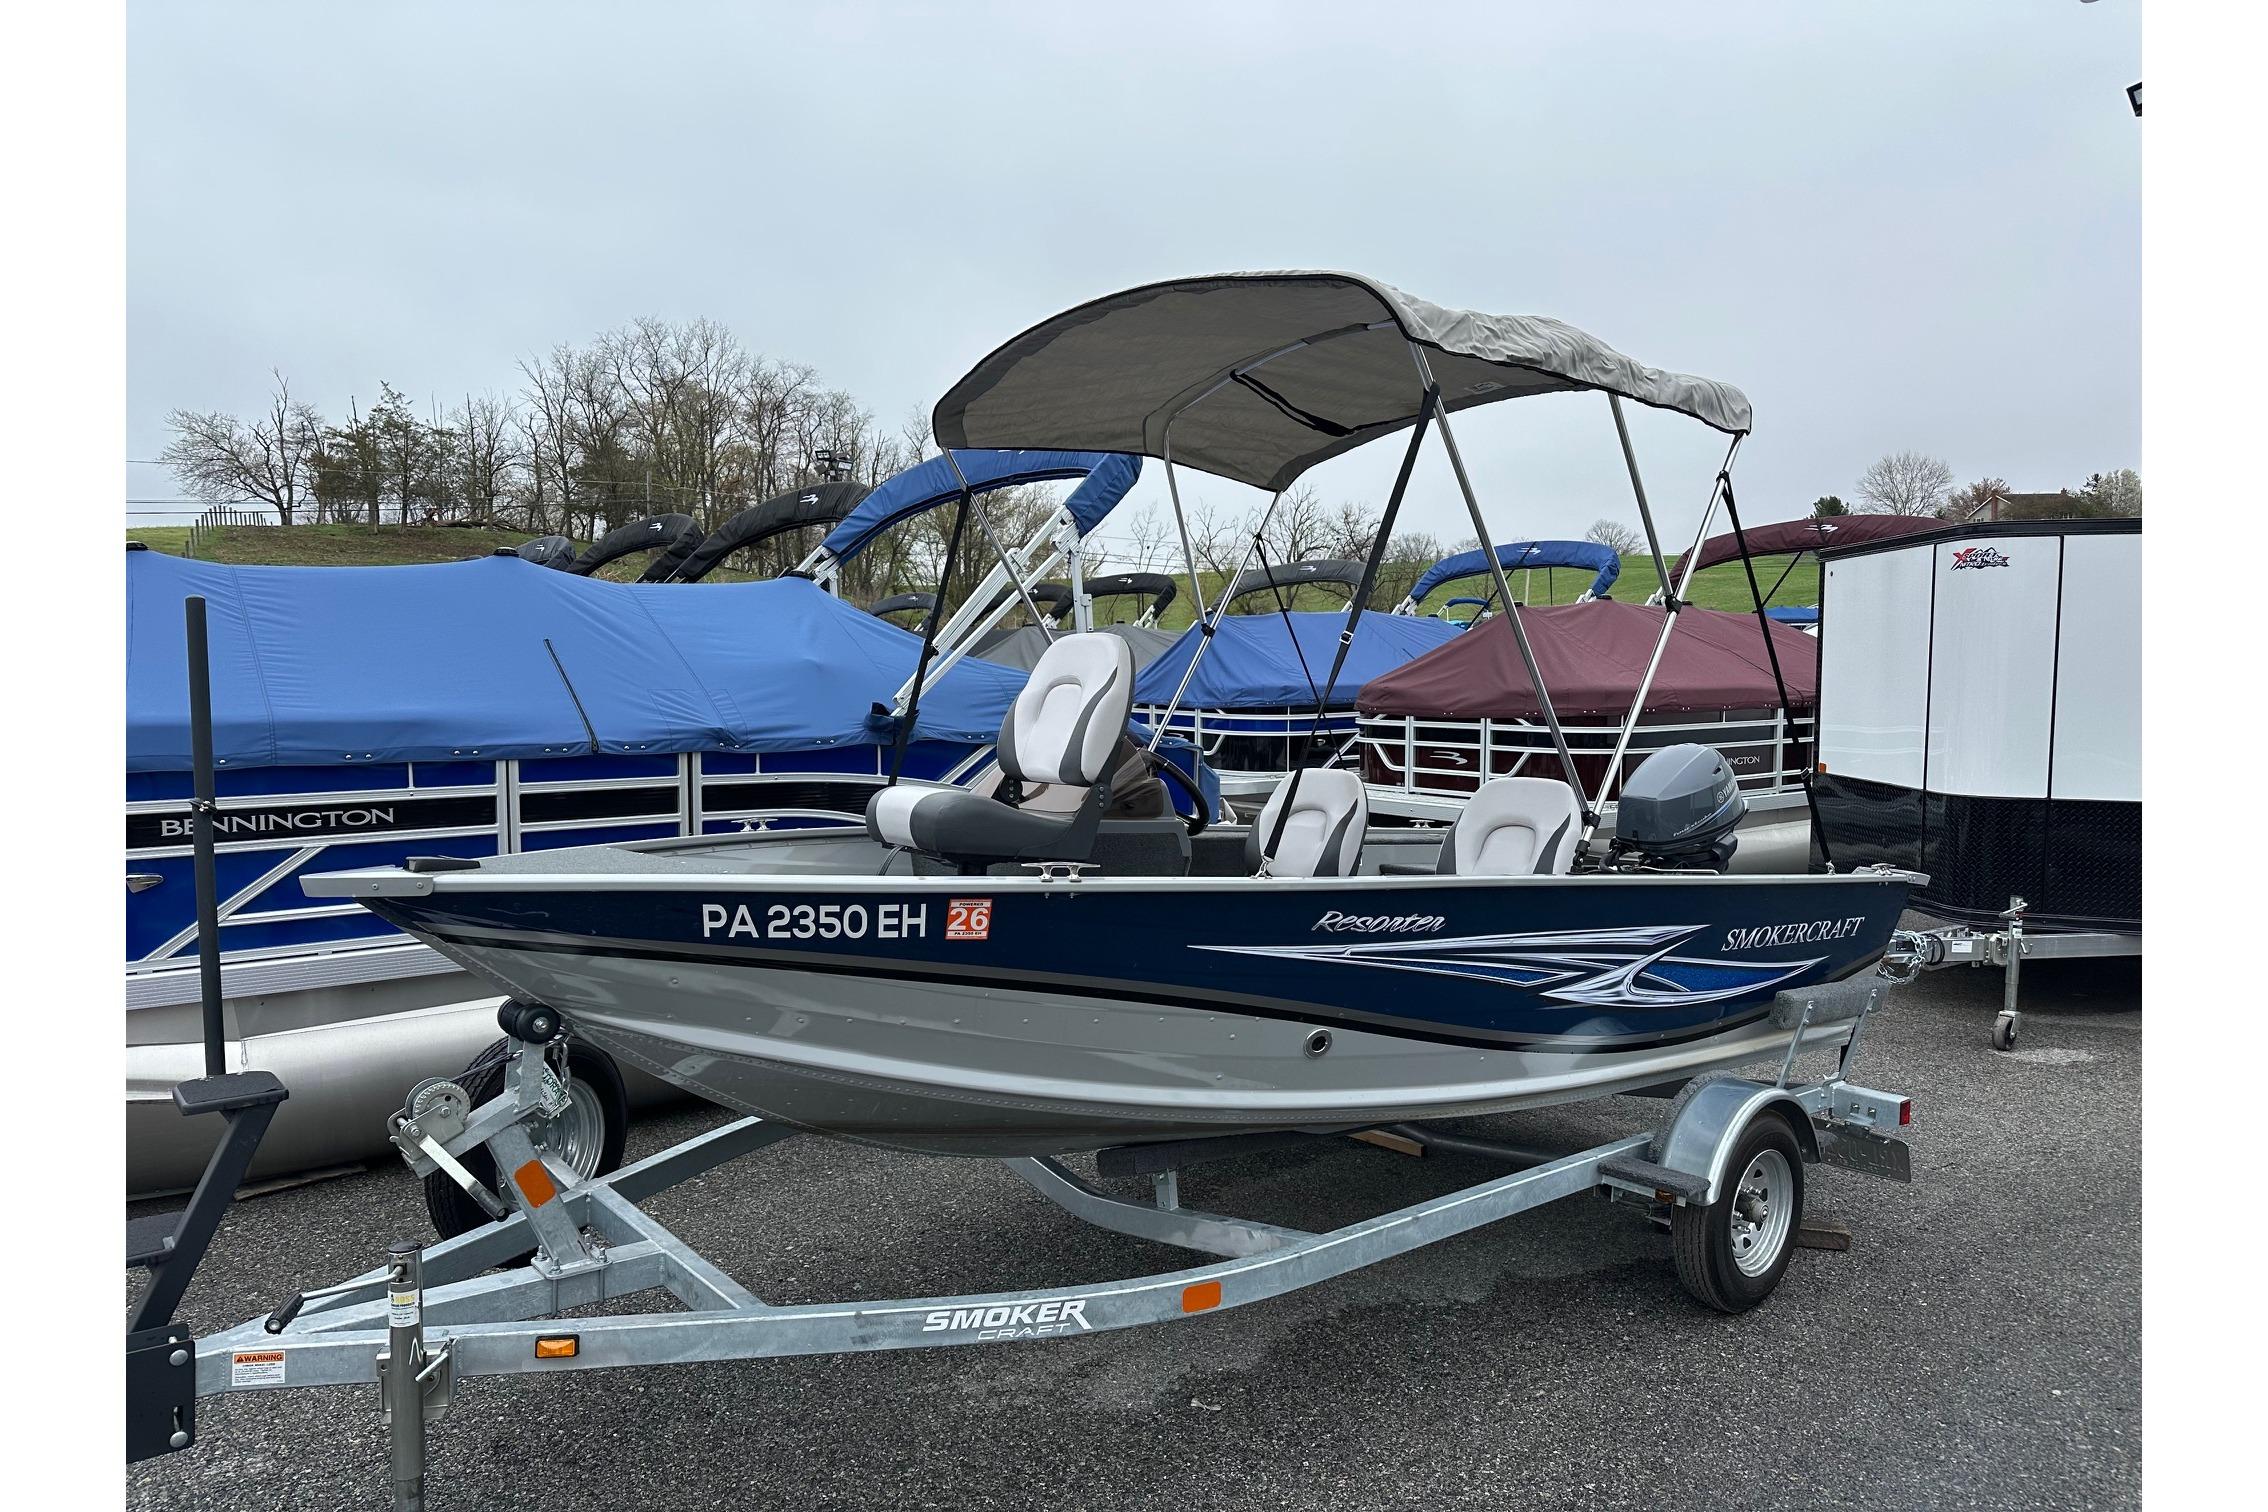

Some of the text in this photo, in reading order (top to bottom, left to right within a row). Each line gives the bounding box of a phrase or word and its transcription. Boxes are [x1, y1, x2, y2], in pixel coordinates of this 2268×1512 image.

[1726, 755, 1760, 765] INGTON
[160, 807, 395, 836] BENNINGTON
[702, 903, 927, 938] PA 2350 EH
[947, 907, 989, 931] 26
[1720, 916, 1866, 952] SMOKERCRAFT
[922, 1299, 1093, 1332] SMOKER
[977, 1322, 1071, 1341] CRAFT
[243, 1353, 283, 1362] WARNING
